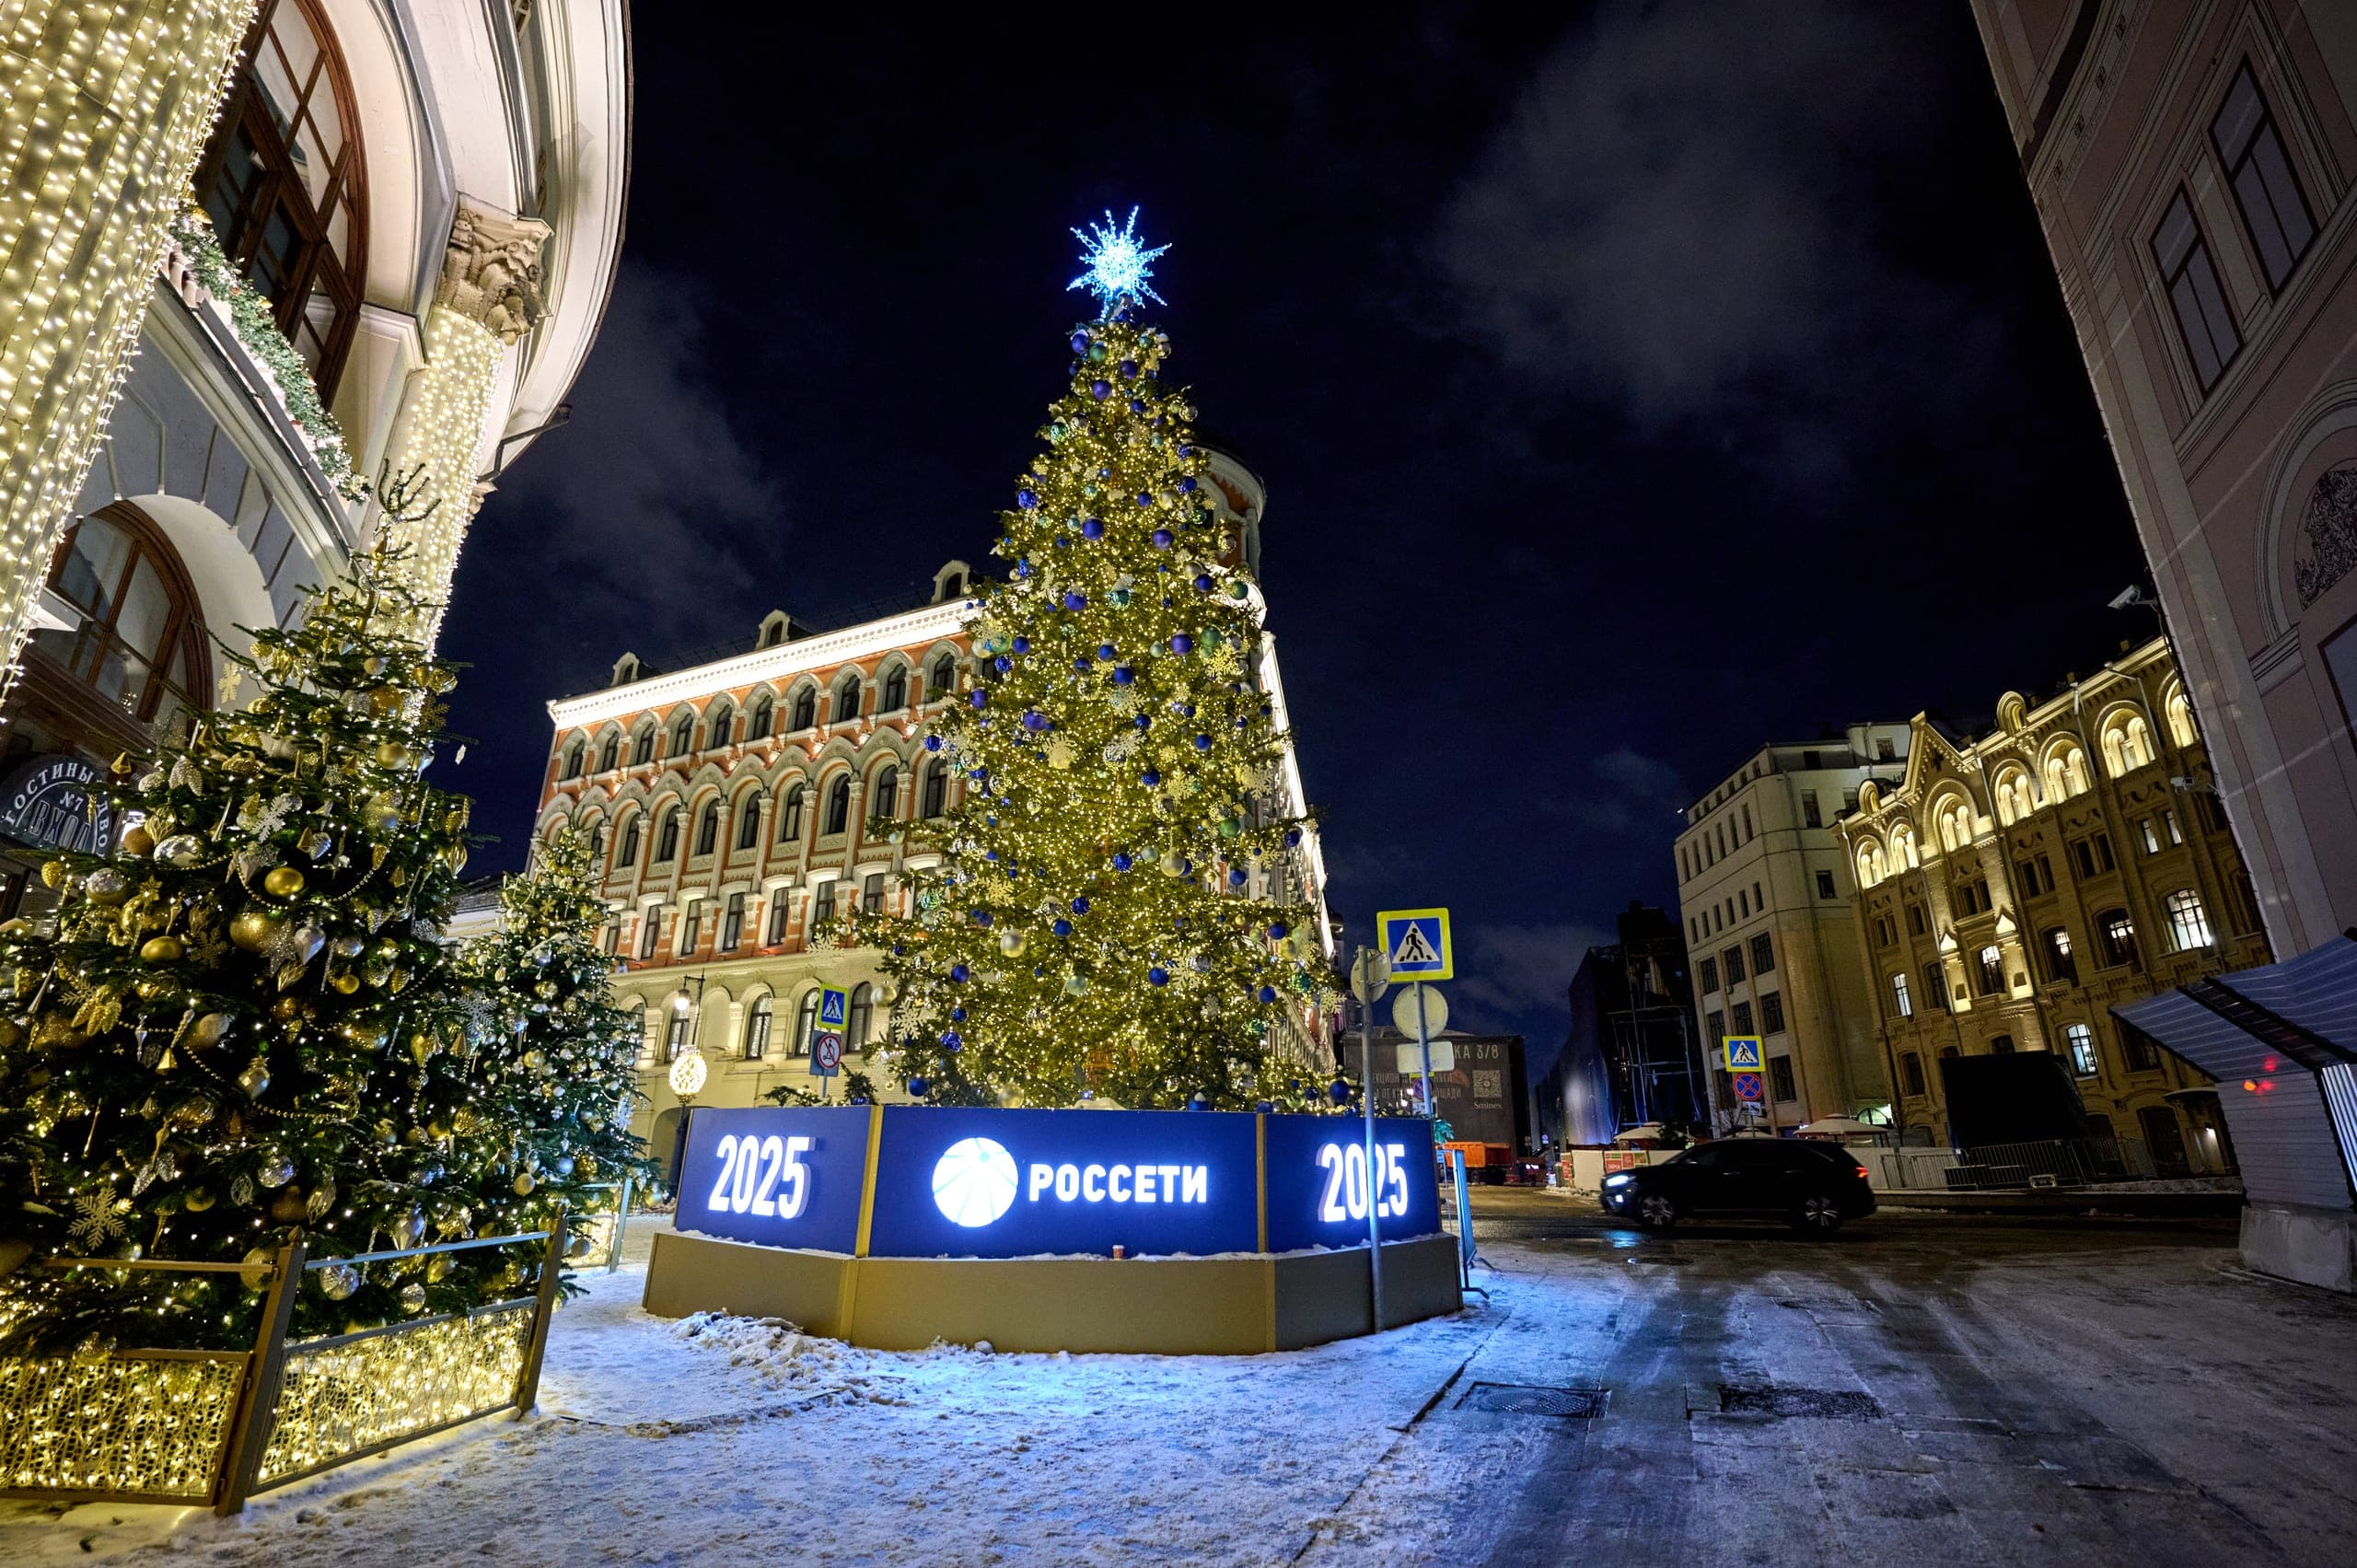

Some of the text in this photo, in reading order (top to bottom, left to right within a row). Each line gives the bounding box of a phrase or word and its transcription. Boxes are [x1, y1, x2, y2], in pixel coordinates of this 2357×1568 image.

[5, 762, 102, 826] ГОСТИНЫ
[1476, 1044, 1499, 1059] 3/8
[708, 1134, 811, 1219] 2025
[1029, 1164, 1207, 1203] РОССЕТИ
[1320, 1143, 1409, 1223] 2025
